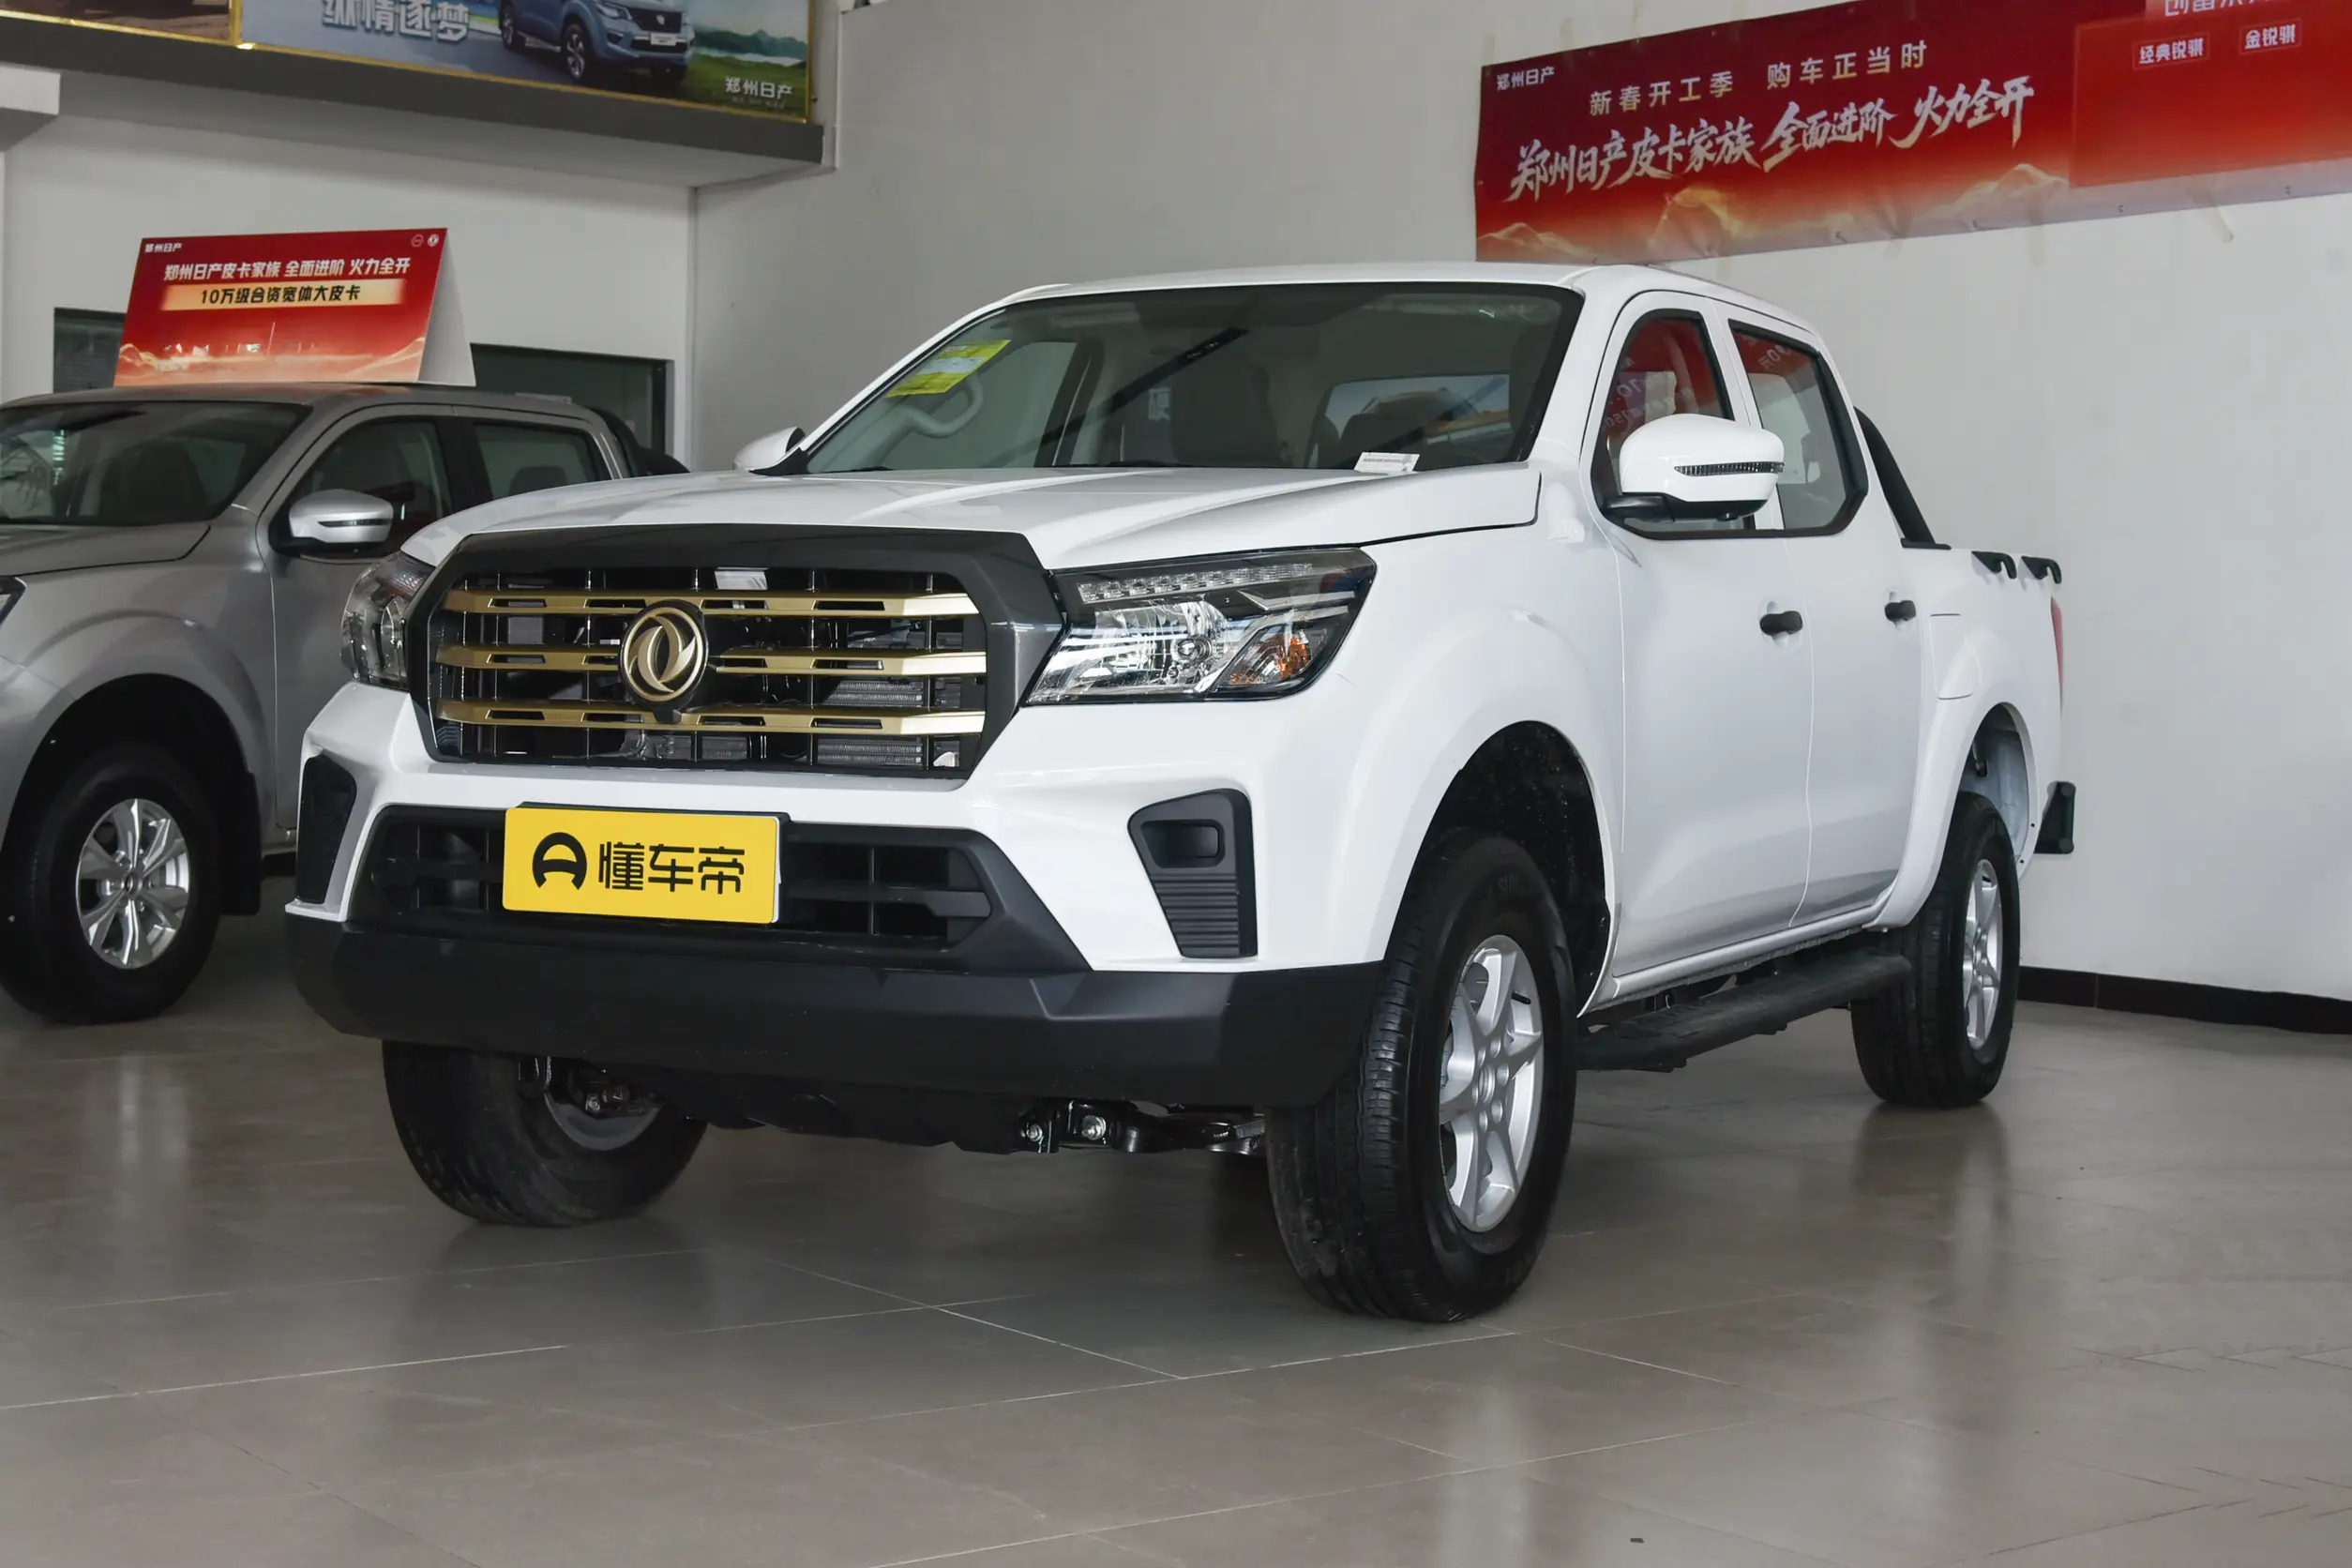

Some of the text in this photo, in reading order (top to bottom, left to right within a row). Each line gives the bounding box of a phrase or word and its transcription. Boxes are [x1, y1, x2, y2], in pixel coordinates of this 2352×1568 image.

[2244, 24, 2297, 50] 金锐骐
[725, 76, 793, 99] 郑州日产
[1496, 66, 1556, 91] 郑州日产
[1590, 39, 1928, 116] 新春开工季 购车正当时
[1502, 75, 2035, 203] 郑州日产皮卡家族 全面进阶 火力全开
[144, 242, 183, 253] 郑州日产
[163, 257, 411, 281] 郑州日产皮卡家族 全面进阶 火力全开
[201, 284, 361, 305] 10万级合资宽体大皮卡
[598, 841, 746, 896] 懂车帝
